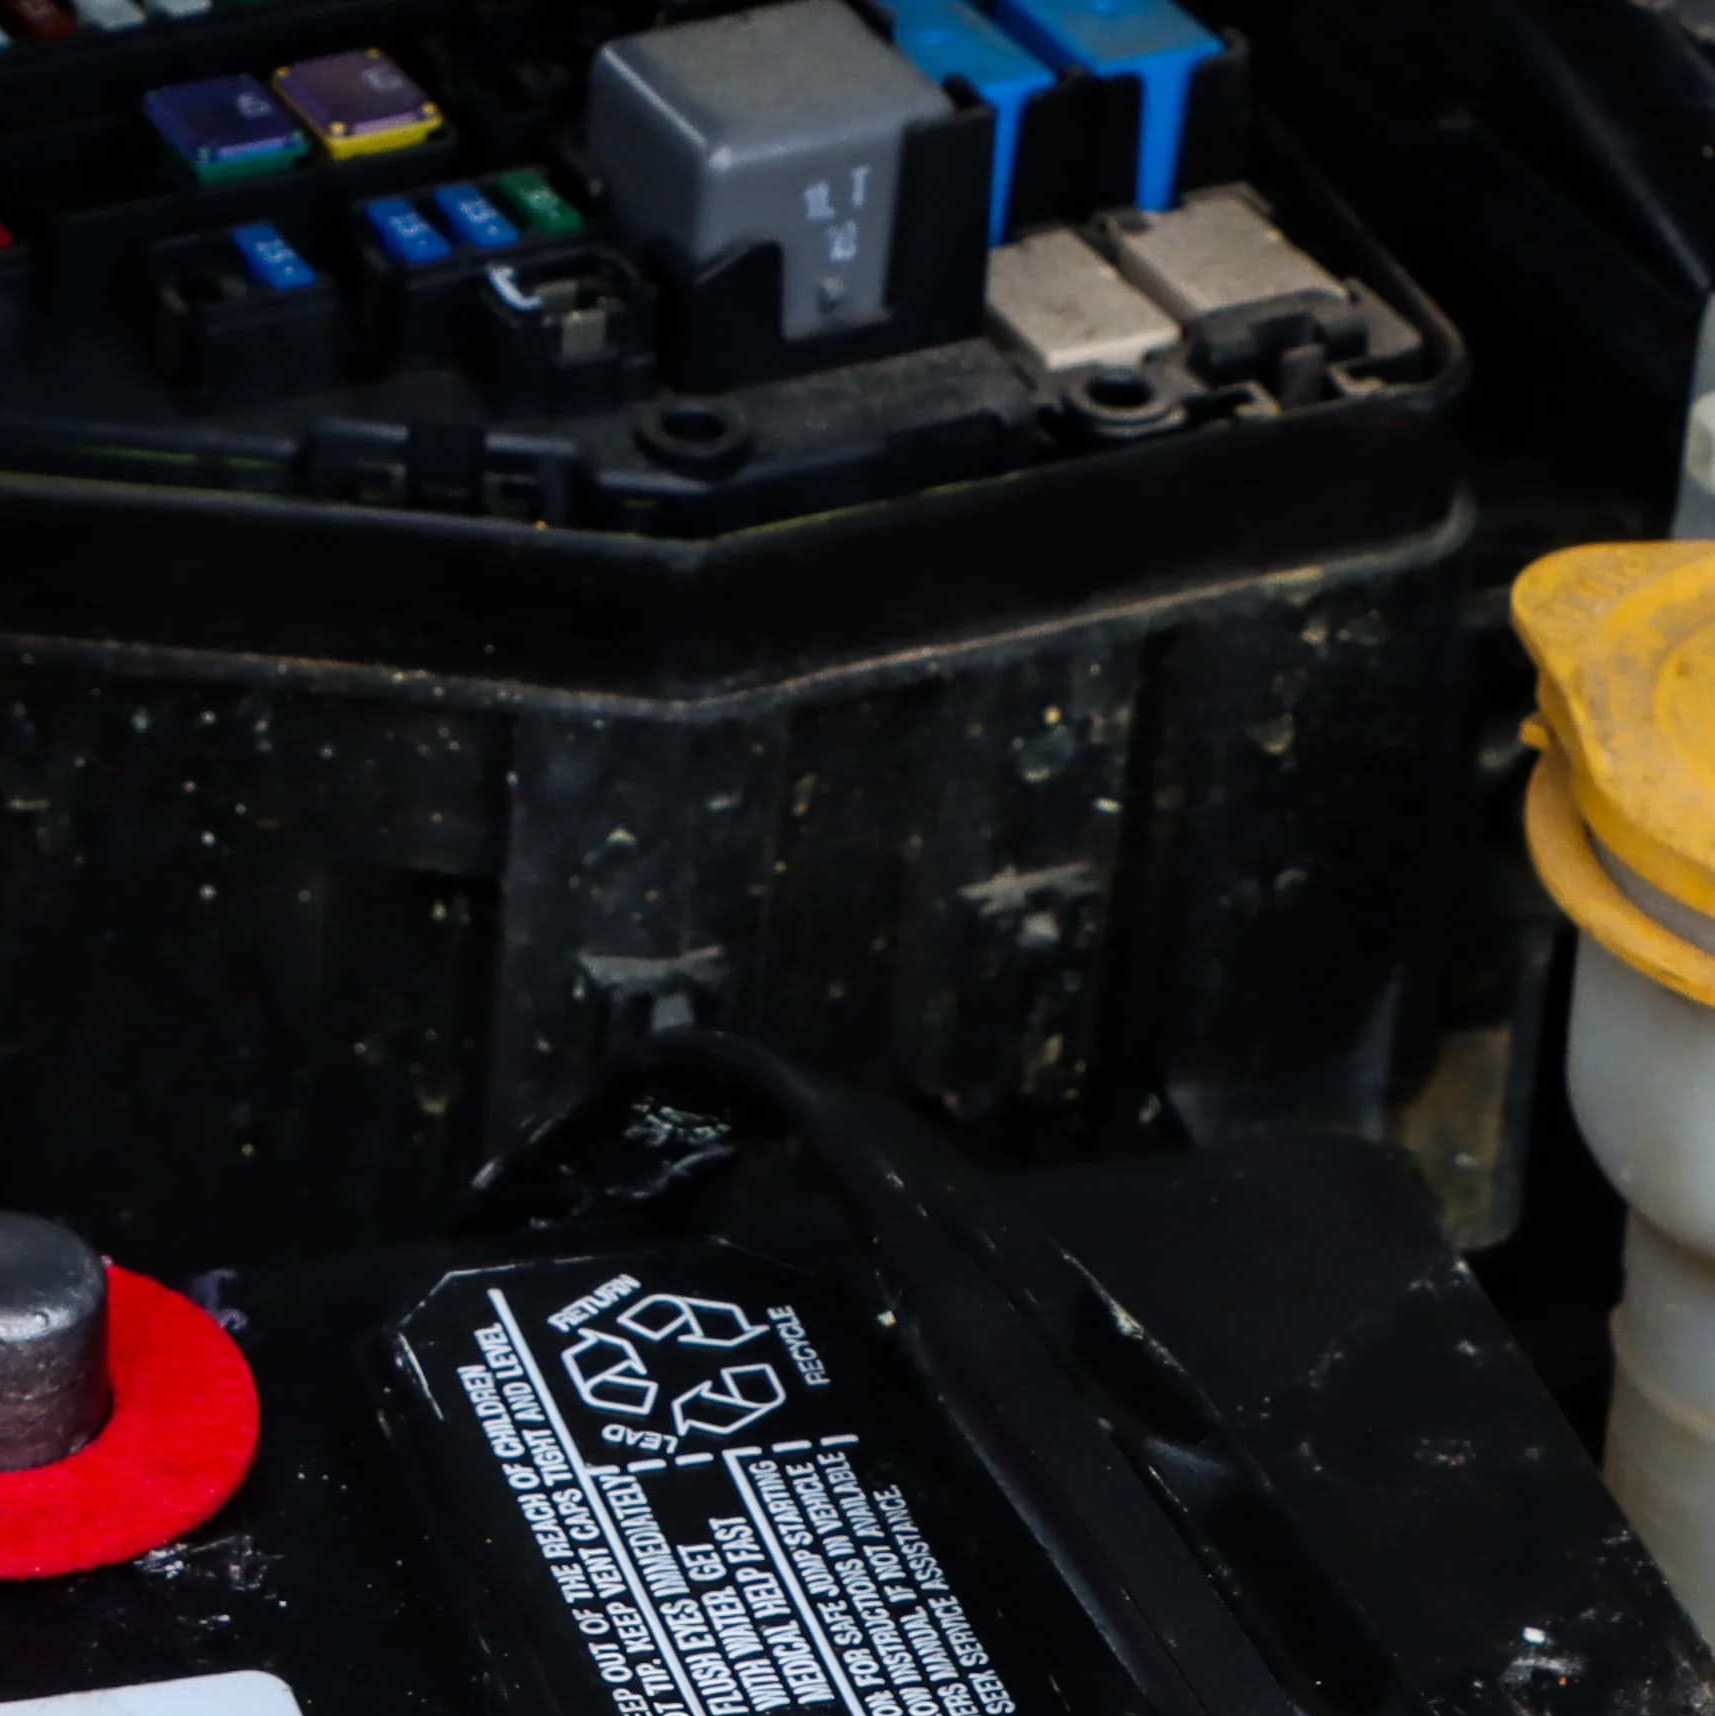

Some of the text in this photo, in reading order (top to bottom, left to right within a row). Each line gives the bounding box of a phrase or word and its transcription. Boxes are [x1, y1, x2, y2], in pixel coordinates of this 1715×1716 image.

[545, 1271, 643, 1334] RETURN
[474, 1322, 524, 1379] LEVEL
[767, 1305, 830, 1386] RECYCLE
[457, 1364, 525, 1458] CHILDREN
[502, 1381, 545, 1421] AND
[521, 1429, 573, 1487] TIGHT
[600, 1422, 680, 1456] LEAD
[502, 1463, 541, 1490] OF
[785, 1462, 843, 1535] VEHICLE
[517, 1493, 575, 1559] REACH
[551, 1488, 600, 1541] CAPS
[676, 1543, 727, 1581] GET
[822, 1535, 856, 1557] IN
[550, 1563, 594, 1604] THE
[578, 1547, 627, 1599] VENT
[599, 1474, 749, 1716] FLUSH EYES IMMEDIATELY
[873, 1484, 1016, 1715] SEEK SERVICE ASSISTANCE.
[571, 1608, 610, 1635] OF
[605, 1601, 655, 1654] KEEP
[708, 1516, 835, 1705] MEDICAL HELP FAST
[834, 1558, 922, 1685] INSTRUCTIONS
[588, 1642, 633, 1683] OUT
[635, 1658, 675, 1697] TIP.
[733, 1658, 791, 1712] WITH
